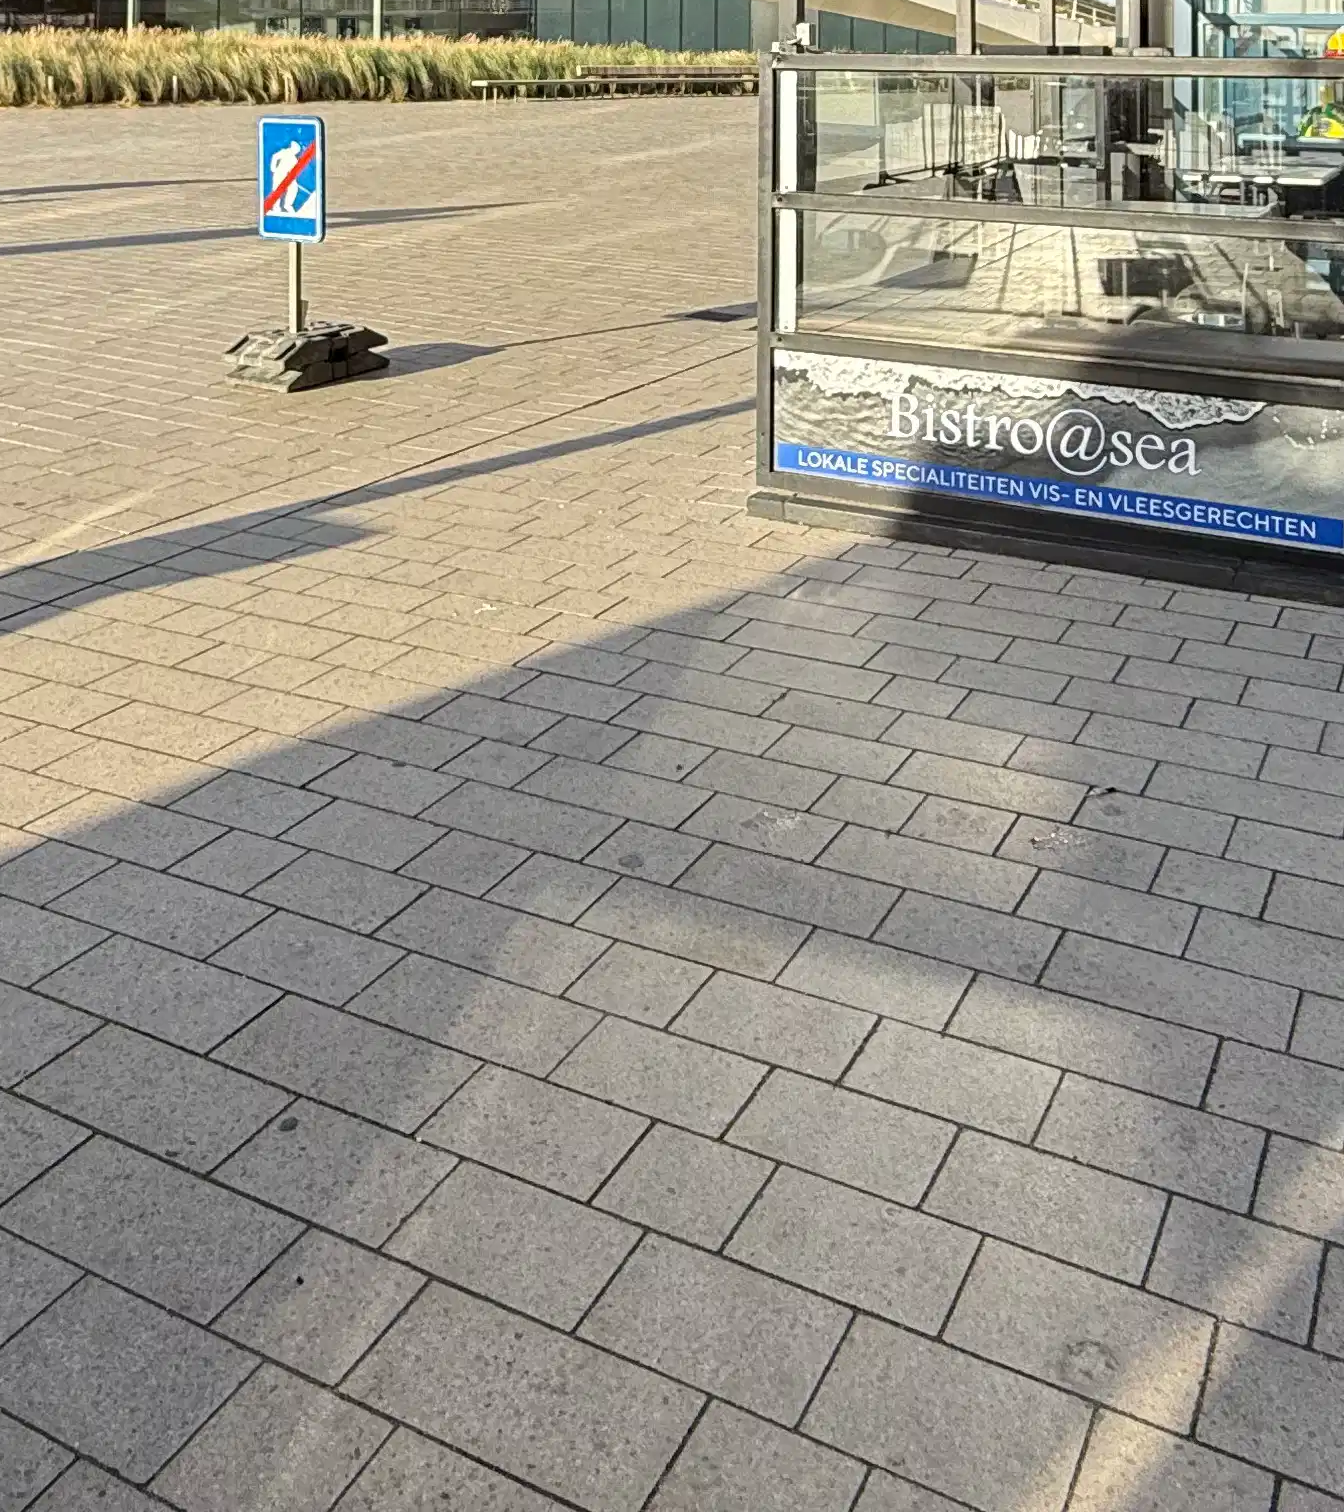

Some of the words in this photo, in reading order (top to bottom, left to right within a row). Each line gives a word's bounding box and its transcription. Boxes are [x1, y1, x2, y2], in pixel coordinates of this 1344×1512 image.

[885, 391, 1202, 476] Bistro@sea
[797, 449, 869, 475] LOKALE
[871, 459, 1024, 497] SPECIALITEITEN
[1029, 481, 1069, 502] VIS-
[1075, 488, 1103, 508] EN
[1108, 492, 1317, 539] VLEESGERECHTEN
